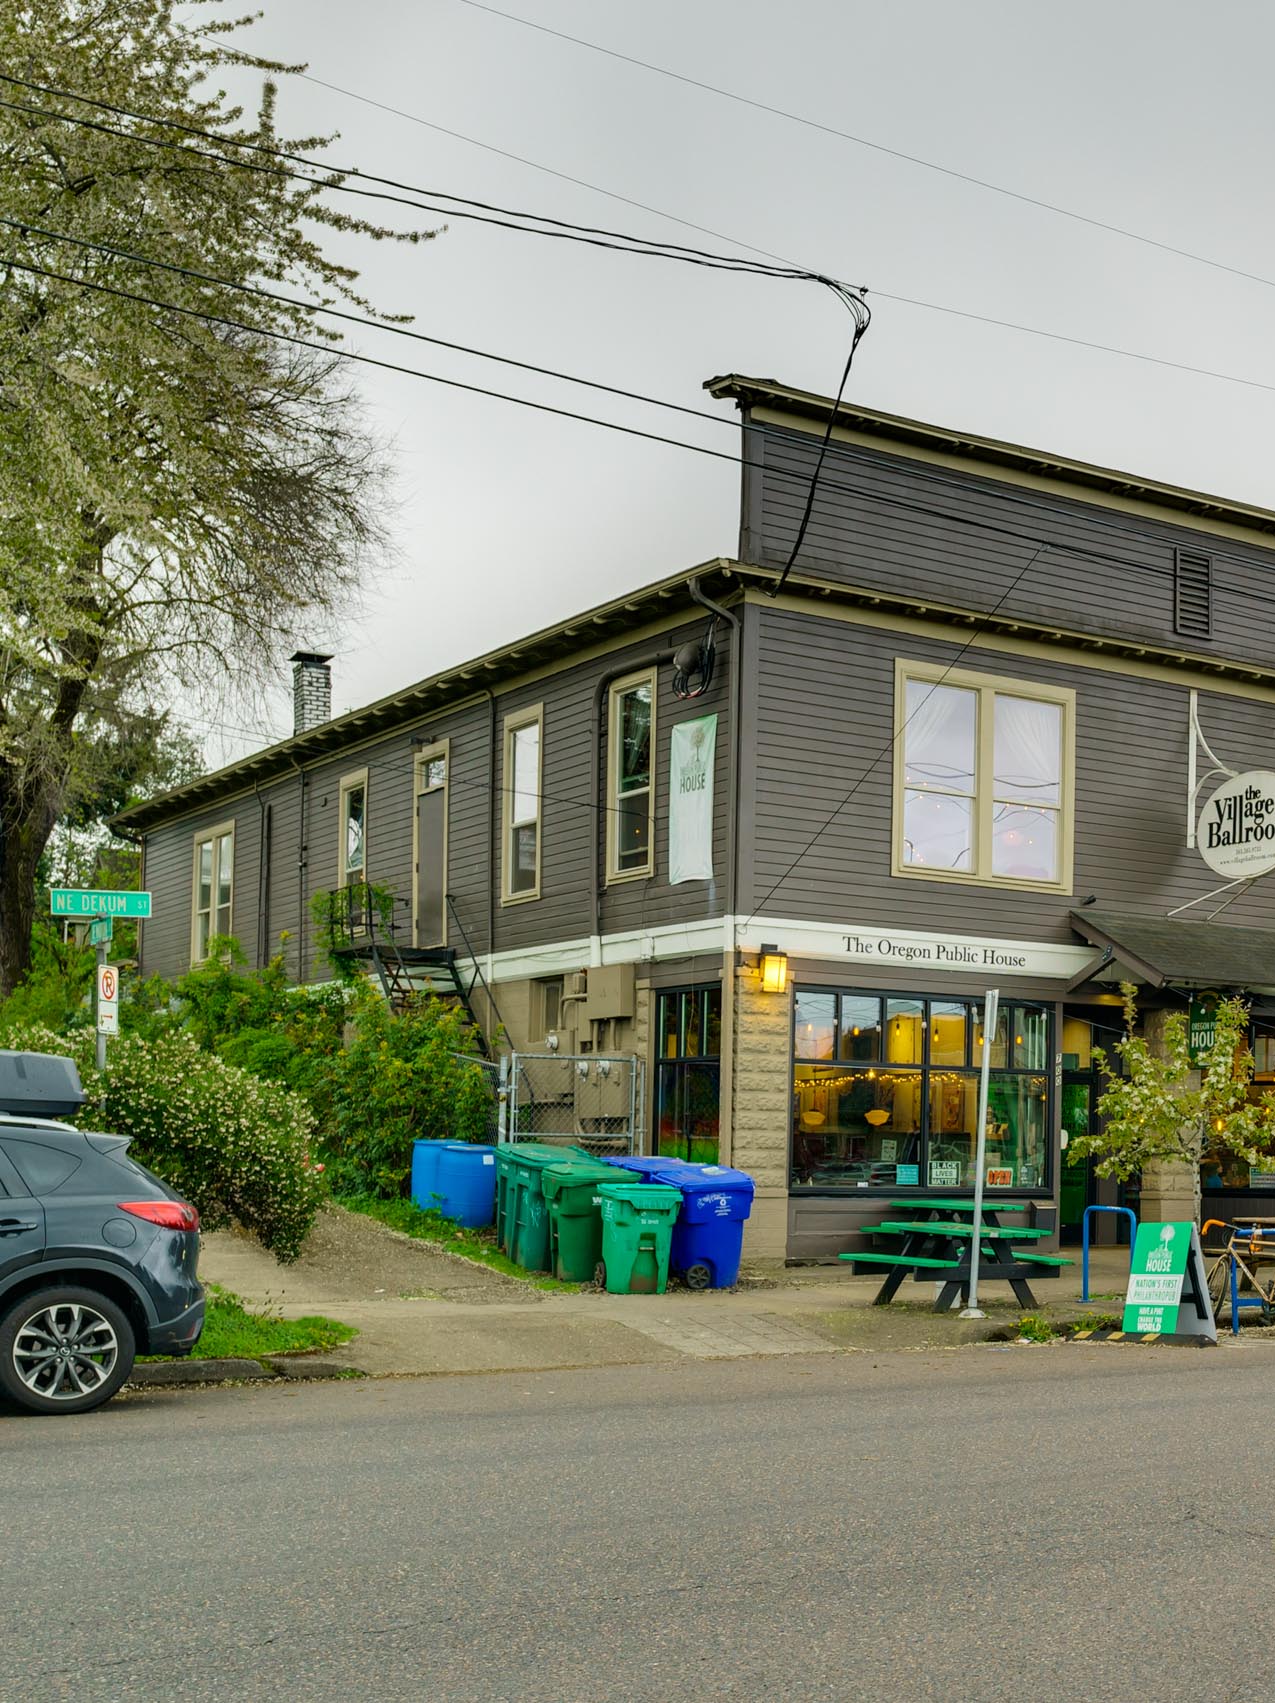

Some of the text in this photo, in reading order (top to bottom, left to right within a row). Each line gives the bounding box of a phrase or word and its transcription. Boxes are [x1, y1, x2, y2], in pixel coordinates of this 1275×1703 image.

[679, 772, 706, 794] HOUSE
[1245, 785, 1261, 800] the
[1213, 794, 1275, 825] Village
[56, 894, 147, 912] NE DEKUM ST
[842, 936, 1027, 967] The Oregon Public House
[1191, 1031, 1214, 1048] HOU
[931, 1178, 957, 1186] MATTER
[1146, 1259, 1172, 1272] HOUSE
[1135, 1279, 1178, 1289] NATION'S FIRST
[1137, 1323, 1162, 1333] WORLD
